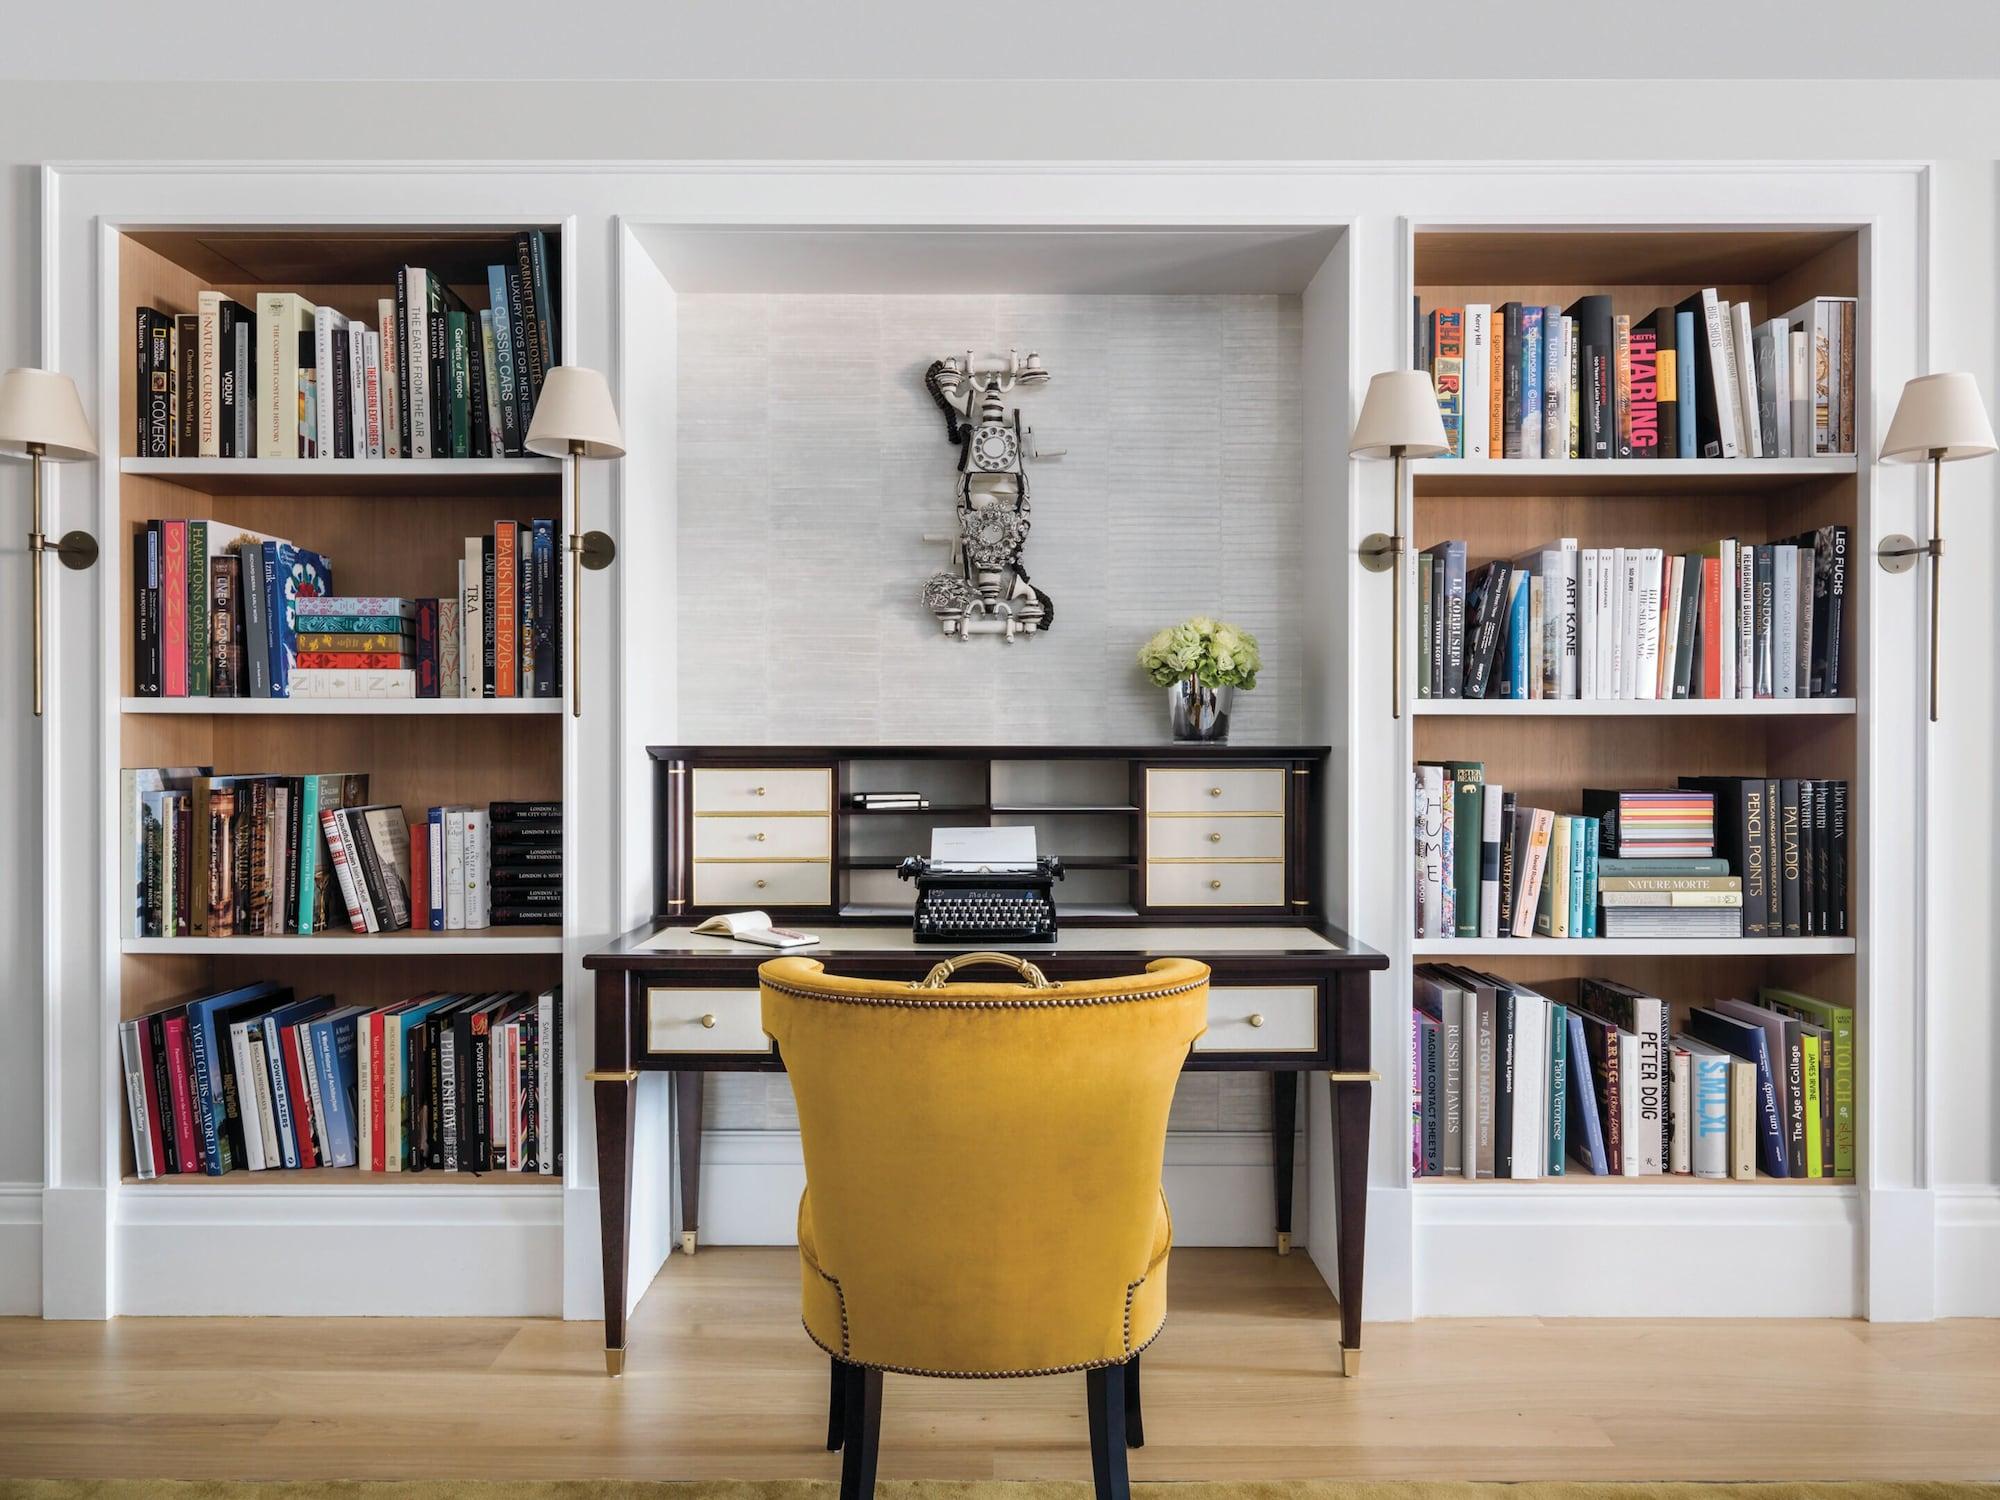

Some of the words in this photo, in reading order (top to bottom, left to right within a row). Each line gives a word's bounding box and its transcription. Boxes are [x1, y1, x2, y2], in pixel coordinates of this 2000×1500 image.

[519, 242, 527, 252] LE
[495, 288, 503, 302] THE
[510, 274, 521, 317] LUXURY
[519, 255, 532, 302] CABINET
[412, 307, 420, 326] THE
[526, 306, 534, 319] DE
[1474, 314, 1482, 333] Kerry
[1706, 306, 1718, 320] BIG
[138, 314, 146, 348] Nukuoro
[204, 320, 212, 372] NATURAL
[412, 330, 422, 362] EARTH
[455, 328, 463, 360] Gardens
[495, 306, 509, 363] CLASSIC
[515, 320, 524, 347] TOYS
[1440, 312, 1460, 356] THE
[1493, 335, 1501, 353] Egon
[1708, 323, 1720, 347] SHOTS
[517, 351, 526, 372] FOR
[1549, 337, 1557, 381] TURNER
[1620, 330, 1628, 371] TURNER
[367, 367, 376, 379] THE
[414, 366, 422, 394] FROM
[456, 371, 464, 398] Europe
[471, 351, 482, 424] DEBUTANTES
[500, 366, 513, 401] CARS
[520, 377, 528, 400] MEN
[1438, 364, 1461, 414] ART
[203, 375, 212, 443] CURIOSITIES
[367, 380, 378, 408] MODERN
[414, 398, 423, 418] THE
[1548, 389, 1558, 408] THE
[1631, 342, 1657, 447] HARING
[152, 401, 166, 452] COVERS
[368, 409, 379, 446] EXPLORERS
[416, 420, 424, 437] AIR
[504, 406, 513, 429] BOOK
[1493, 404, 1501, 441] Beginning
[1548, 410, 1557, 430] SEA
[498, 538, 512, 579] PARIS
[1835, 531, 1845, 554] LEO
[193, 528, 203, 600] HAMPTONS
[265, 561, 275, 583] Iznik
[485, 553, 493, 573] LAND
[1743, 554, 1751, 603] REMBRANDT
[1834, 557, 1844, 595] FUCHS
[217, 577, 227, 605] LIVED
[467, 585, 478, 613] TRA
[485, 576, 493, 599] ROVER
[498, 582, 513, 596] IN
[1453, 578, 1461, 593] LE
[1566, 577, 1576, 607] ART
[1783, 576, 1791, 601] HENRI
[219, 609, 227, 617] IN
[485, 602, 493, 644] EXPERIENCE
[498, 599, 512, 625] THE
[1761, 582, 1771, 635] LONDON
[193, 605, 203, 665] GARDENS
[218, 623, 227, 668] LONDON
[1451, 597, 1461, 666] CORBUSIER
[1566, 613, 1576, 656] KANE
[1782, 603, 1791, 679] CARTIER-BRESSON
[498, 630, 512, 669] 1920s
[1748, 793, 1760, 841] PENCIL
[1801, 788, 1813, 828] Havana
[1816, 788, 1826, 828] Panama
[1834, 786, 1845, 838] Bordeaux
[239, 823, 248, 890] VERSAILLES
[337, 813, 350, 845] Beautiful
[345, 843, 356, 866] Britain
[1784, 806, 1798, 880] PALLADIO
[1503, 854, 1511, 889] ALCHEMY
[1628, 881, 1671, 889] NATURE
[1674, 880, 1710, 888] MORTE
[1749, 845, 1762, 896] POINTS
[1502, 904, 1510, 920] ART
[192, 1024, 204, 1061] YACHT
[322, 1037, 331, 1052] World
[1428, 1029, 1436, 1073] MAGNUM
[1448, 1025, 1459, 1086] RUSSELL
[1481, 1029, 1490, 1072] ASTON
[1641, 1032, 1657, 1080] PETER
[197, 1063, 210, 1097] CLUBS
[324, 1053, 333, 1072] History
[1554, 1059, 1564, 1088] Paolo
[1790, 1045, 1799, 1083] Collage
[1808, 1053, 1816, 1077] JAMES
[1841, 1041, 1851, 1103] TOUCH
[224, 1074, 235, 1118] HOLLYWOOD
[272, 1058, 283, 1091] ROWING
[278, 1093, 288, 1128] BLAZERS
[327, 1079, 339, 1111] Architecture
[441, 1039, 455, 1129] PHOTOSHOW
[1428, 1075, 1436, 1118] CONTACT
[1480, 1075, 1489, 1124] MARTIN
[1699, 1061, 1728, 1137] S,M,L,XL
[1763, 1082, 1774, 1112] Dandy
[1793, 1086, 1801, 1096] of
[1447, 1089, 1459, 1133] JAMES
[1553, 1091, 1562, 1140] Veronese
[1642, 1087, 1658, 1120] DOIG
[1792, 1099, 1801, 1119] Age
[202, 1113, 216, 1154] WORLD
[1428, 1121, 1436, 1158] SHEETS
[1769, 1115, 1776, 1129] am
[1793, 1122, 1802, 1141] The
[1836, 1122, 1852, 1154] style
